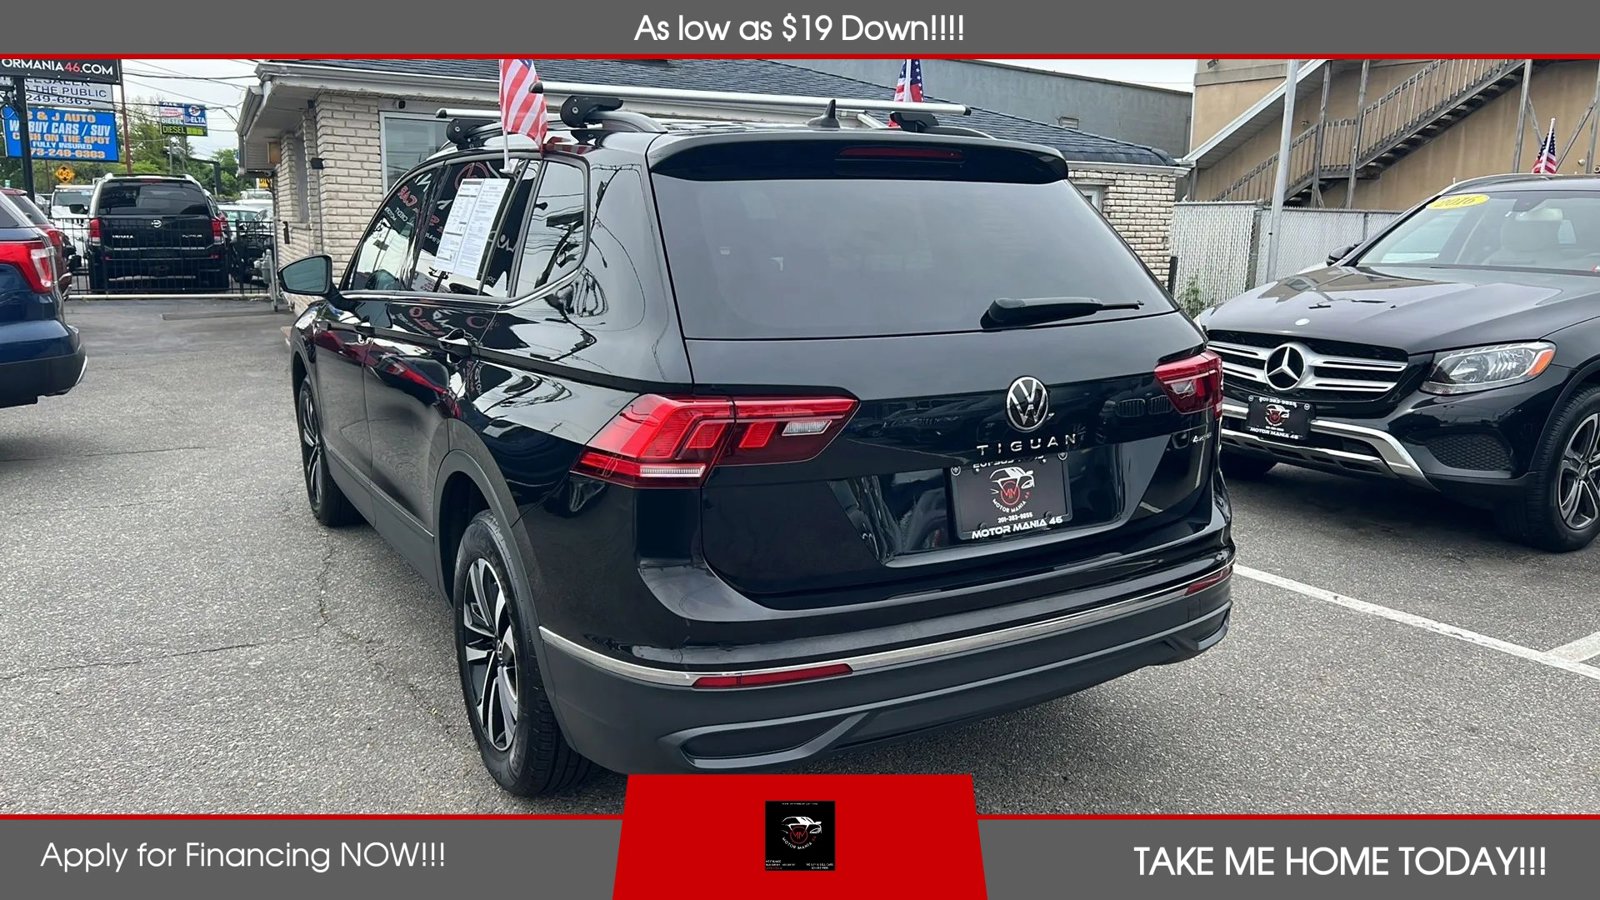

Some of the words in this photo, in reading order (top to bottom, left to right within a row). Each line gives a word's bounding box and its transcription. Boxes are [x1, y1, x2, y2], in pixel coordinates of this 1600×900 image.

[34, 85, 57, 95] THE
[62, 87, 107, 98] PUBLIC
[51, 112, 60, 121] J
[64, 113, 96, 123] AUTO
[28, 121, 49, 134] BUY
[51, 122, 79, 135] CARS
[90, 125, 111, 137] SUV
[162, 126, 186, 135] DIESEL
[44, 134, 59, 142] ON
[63, 134, 81, 143] THE
[84, 135, 111, 145] SPOT
[58, 142, 93, 150] INSURED
[1250, 427, 1269, 435] MOTOR
[976, 433, 1077, 457] TIGUAN
[992, 498, 1010, 513] MOTOR
[1010, 500, 1027, 513] MANIA
[971, 526, 1012, 540] MOTOR
[1013, 518, 1048, 532] MANIA
[1049, 515, 1064, 526] 46
